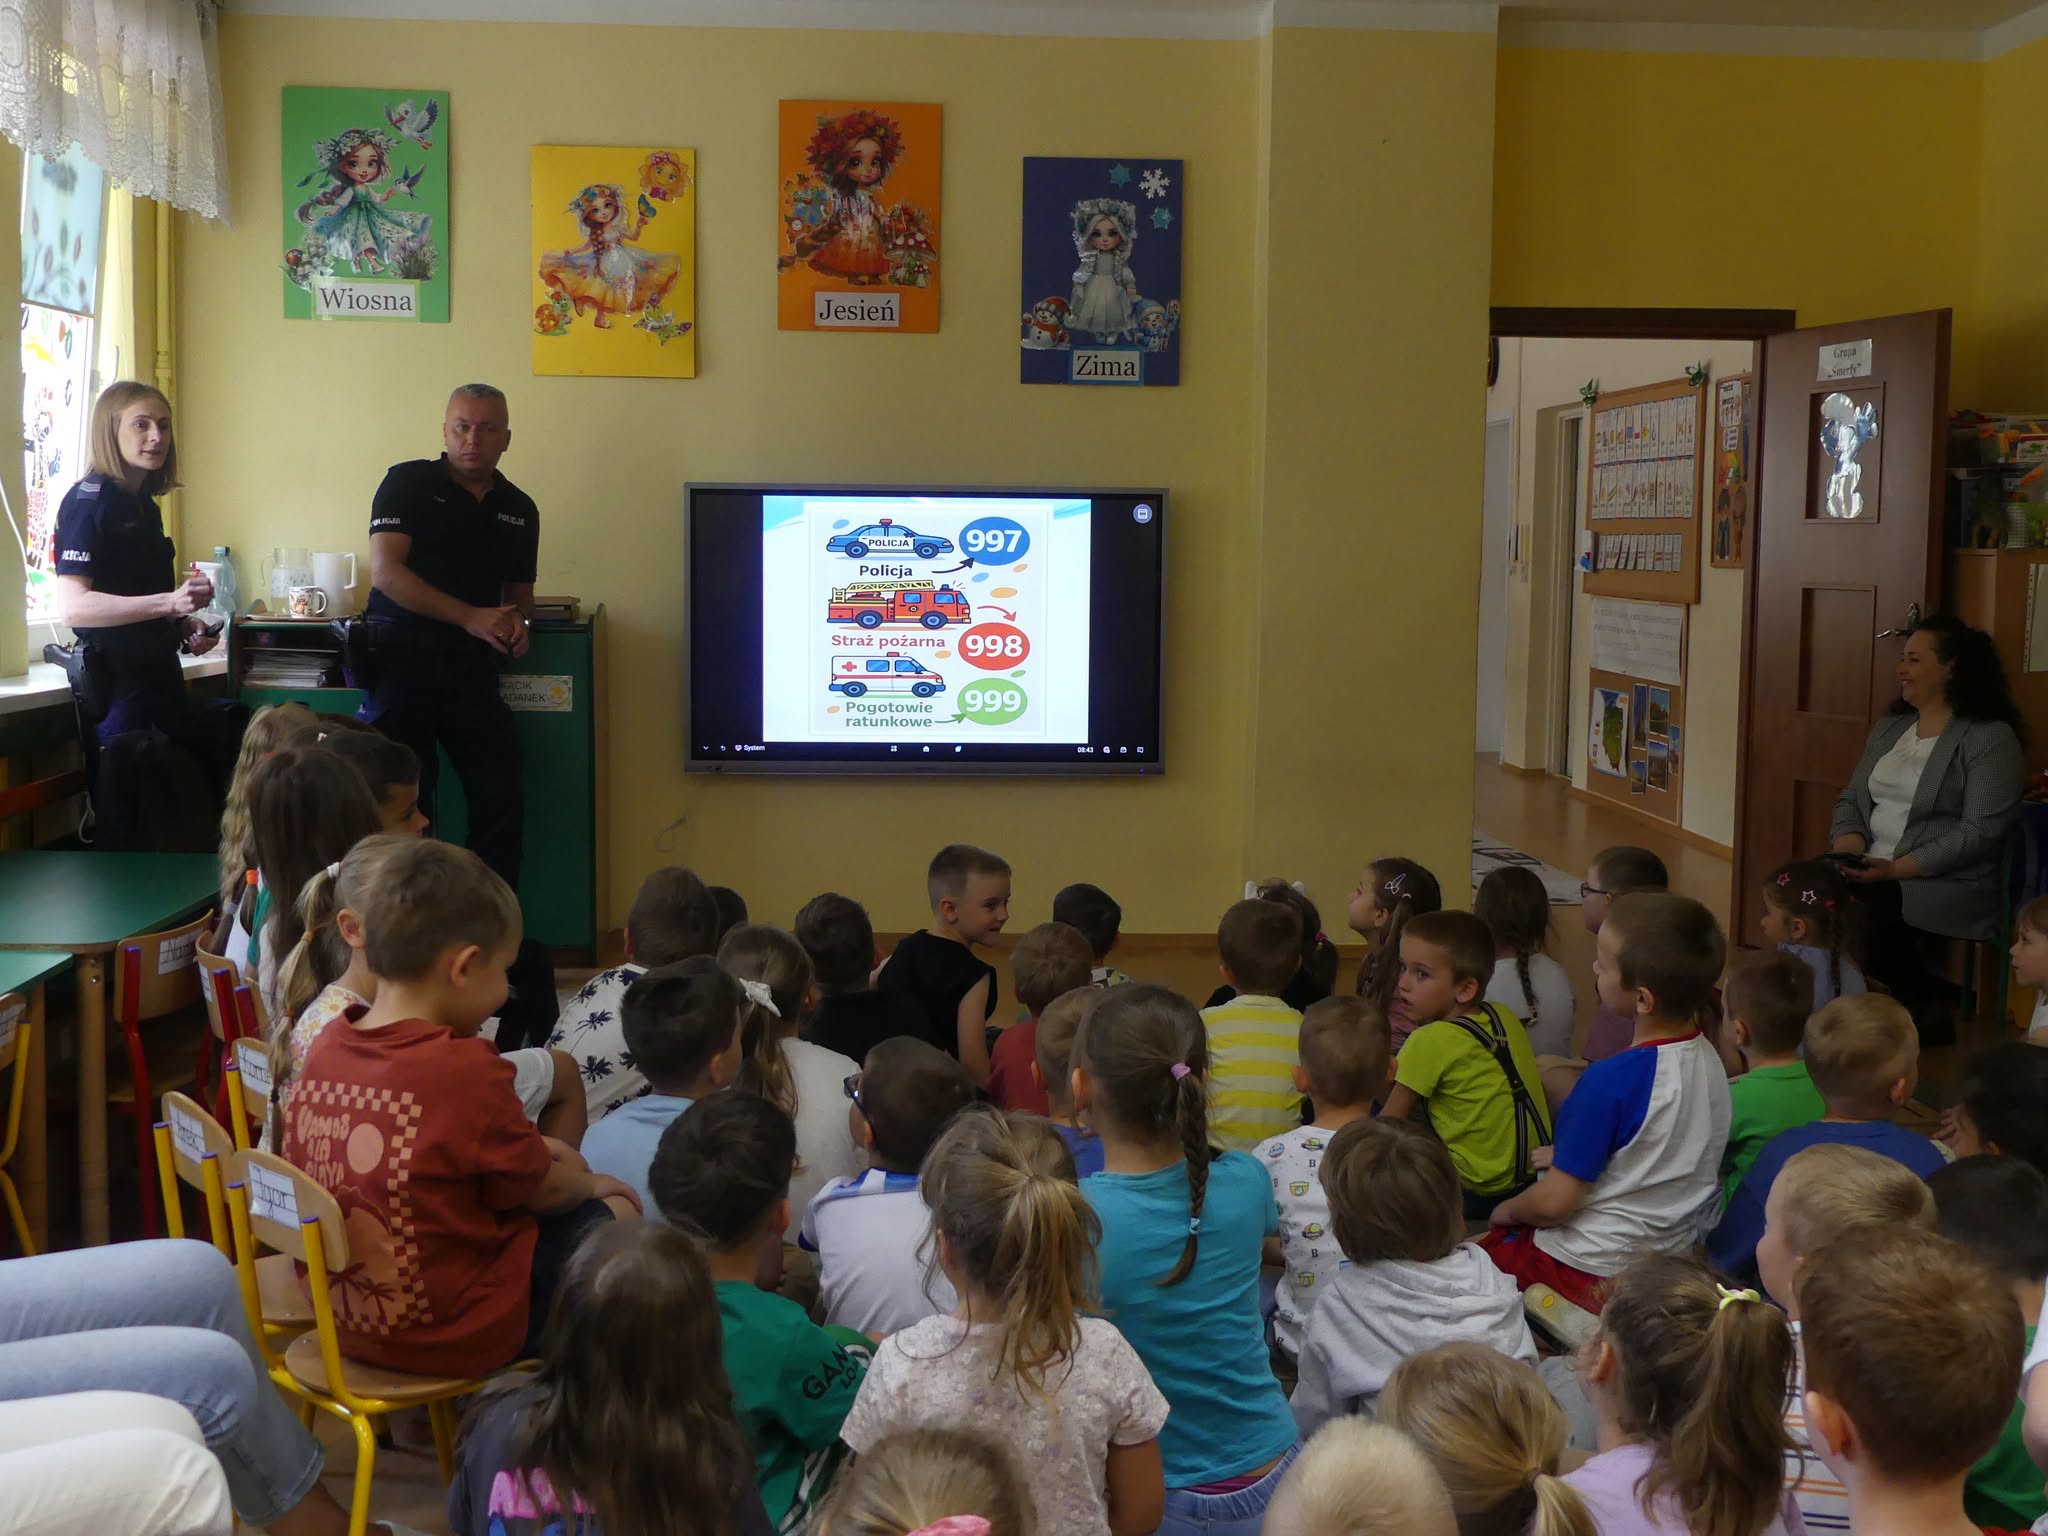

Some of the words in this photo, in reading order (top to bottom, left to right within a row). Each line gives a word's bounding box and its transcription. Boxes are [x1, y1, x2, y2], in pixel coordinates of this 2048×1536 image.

[320, 287, 413, 311] Wiosna
[819, 299, 896, 321] Jesień
[1833, 347, 1857, 360] Grupa
[1076, 354, 1137, 377] Zima
[868, 538, 910, 548] POLICJA
[966, 529, 1022, 553] 997
[859, 565, 913, 579] Policja
[965, 634, 1023, 657] 998
[503, 693, 546, 703] ADANEK
[964, 689, 1021, 712] 999
[846, 702, 933, 715] Pogotowie
[846, 716, 933, 728] ratunkowe
[743, 744, 766, 752] System
[297, 1103, 350, 1144] VAMOS
[1308, 1159, 1317, 1168] B
[1311, 1248, 1319, 1258] B
